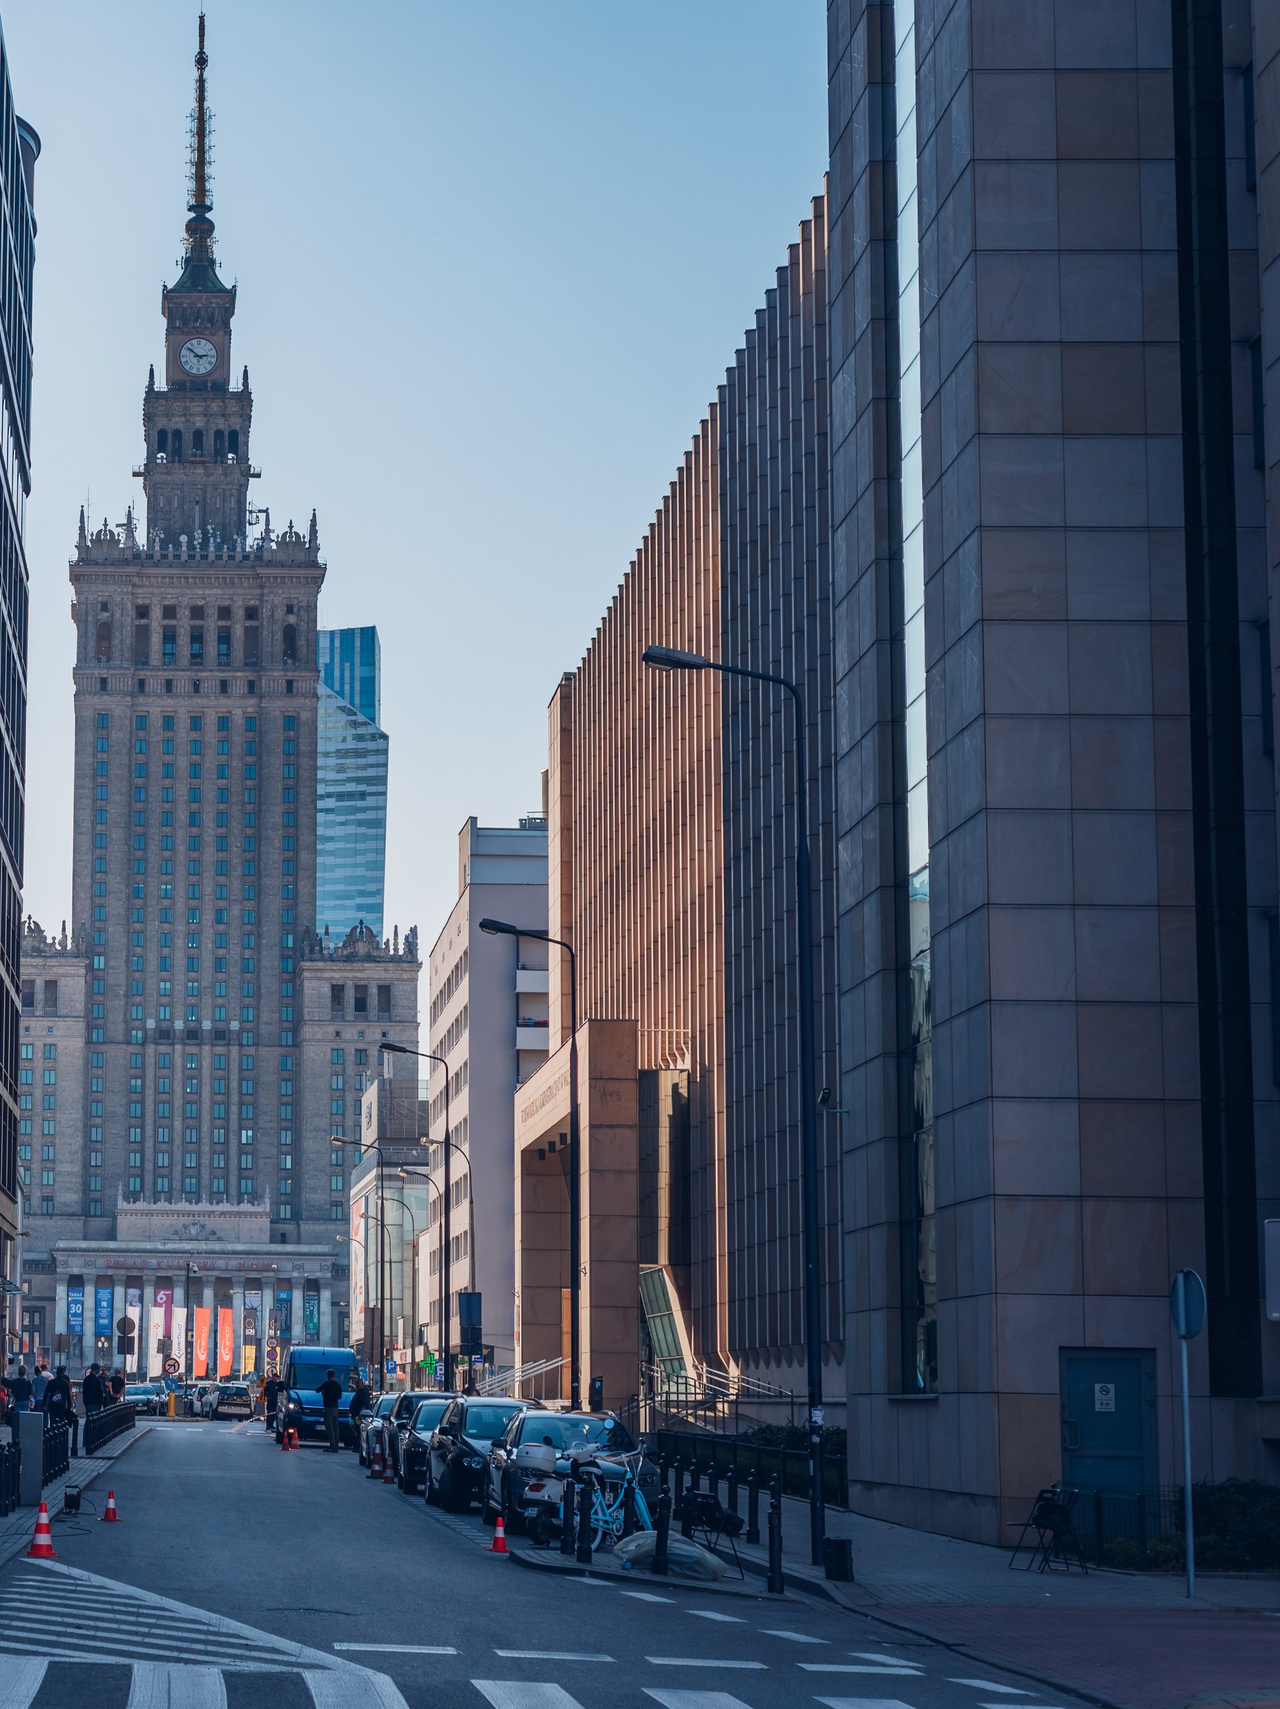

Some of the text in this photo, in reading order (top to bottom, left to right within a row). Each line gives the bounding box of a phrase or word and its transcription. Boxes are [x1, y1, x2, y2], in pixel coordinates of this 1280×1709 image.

[70, 1303, 82, 1314] 30
[388, 1361, 395, 1370] P
[595, 1381, 601, 1389] P
